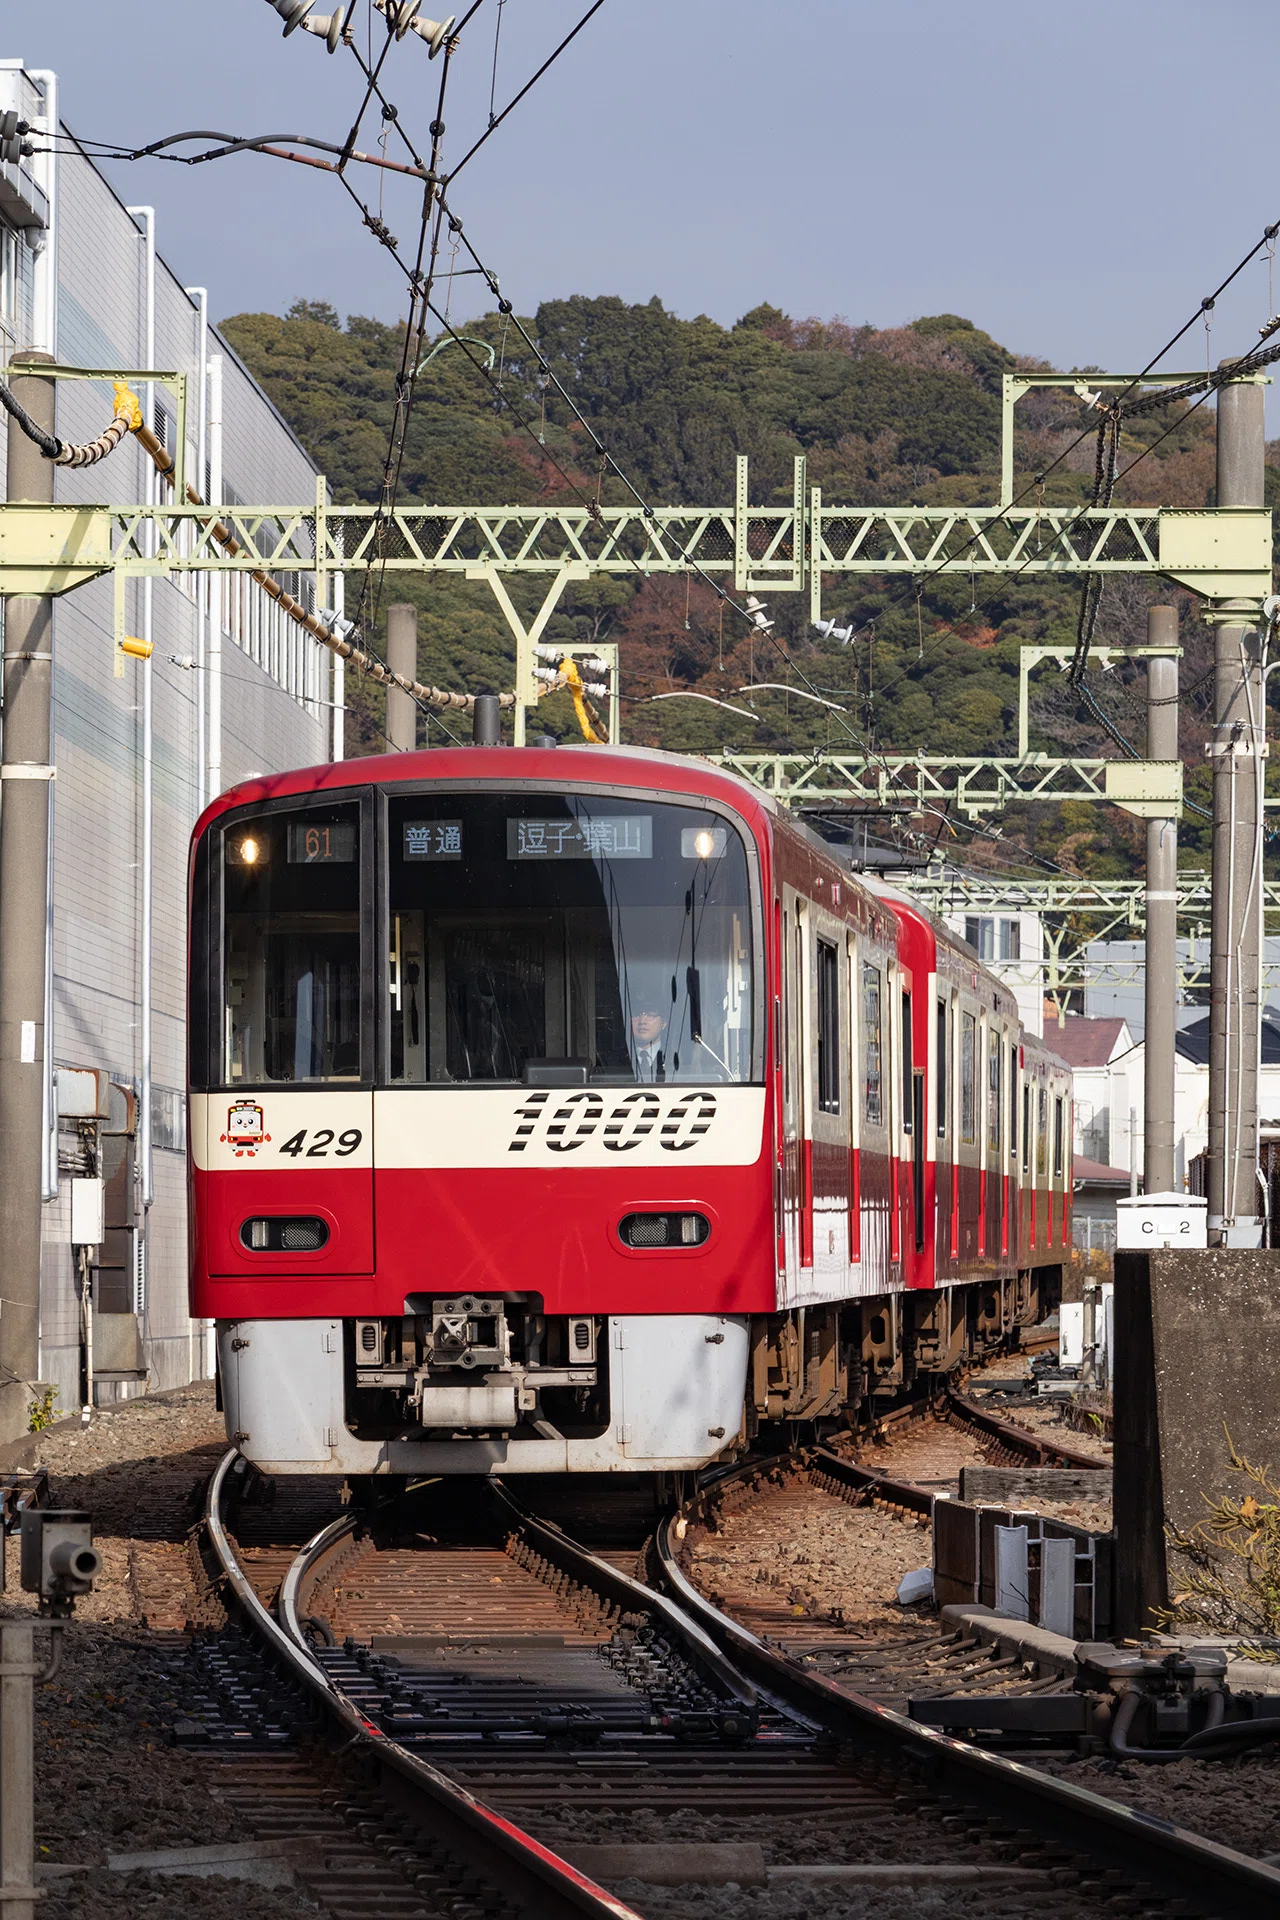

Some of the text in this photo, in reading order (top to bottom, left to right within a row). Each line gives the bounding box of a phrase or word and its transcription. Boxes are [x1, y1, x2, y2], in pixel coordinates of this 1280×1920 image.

[305, 827, 332, 857] 61
[405, 826, 462, 854] 普通
[507, 1092, 717, 1152] 1000
[279, 1128, 362, 1157] 429
[1141, 1220, 1190, 1234] C 2
